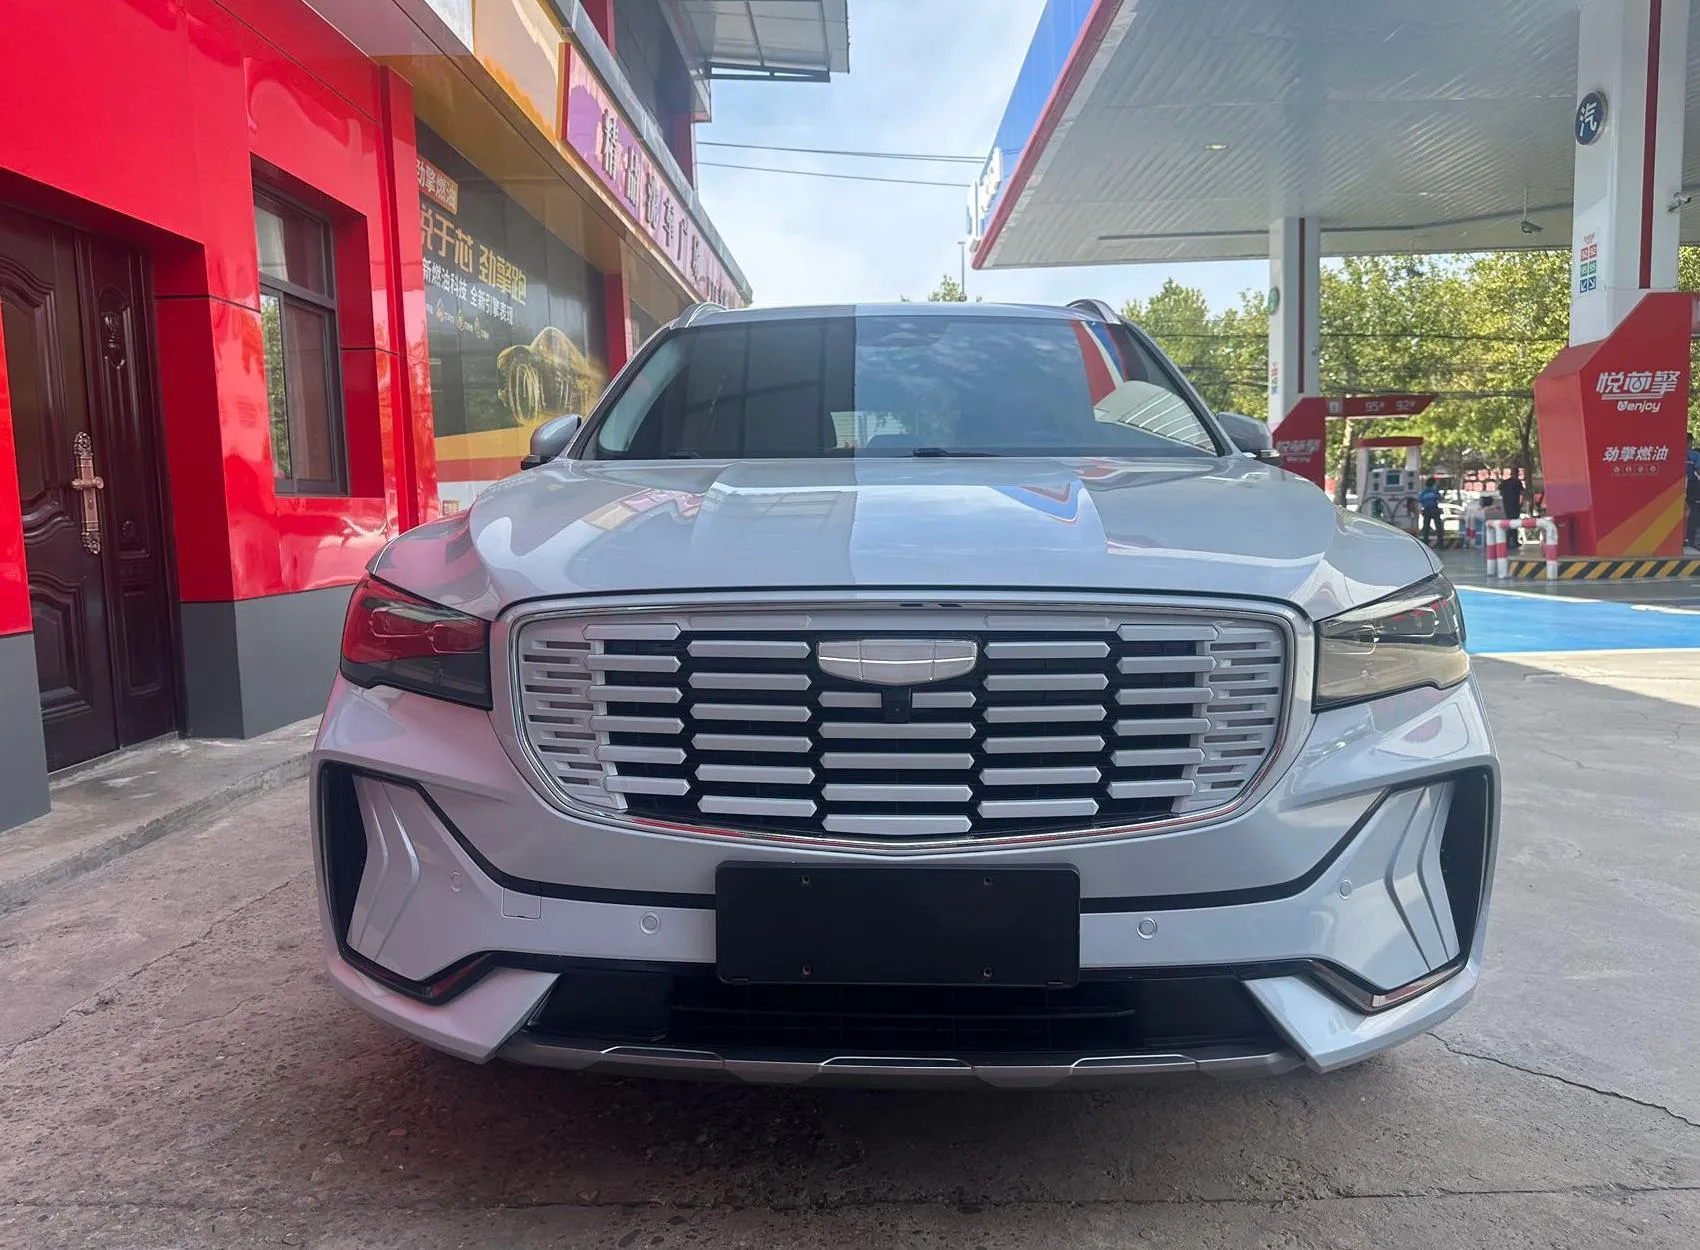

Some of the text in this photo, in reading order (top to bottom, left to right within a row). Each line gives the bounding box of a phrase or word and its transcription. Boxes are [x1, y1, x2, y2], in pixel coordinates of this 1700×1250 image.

[1580, 102, 1597, 136] 汽
[1603, 445, 1669, 462] 劲擎燃油
